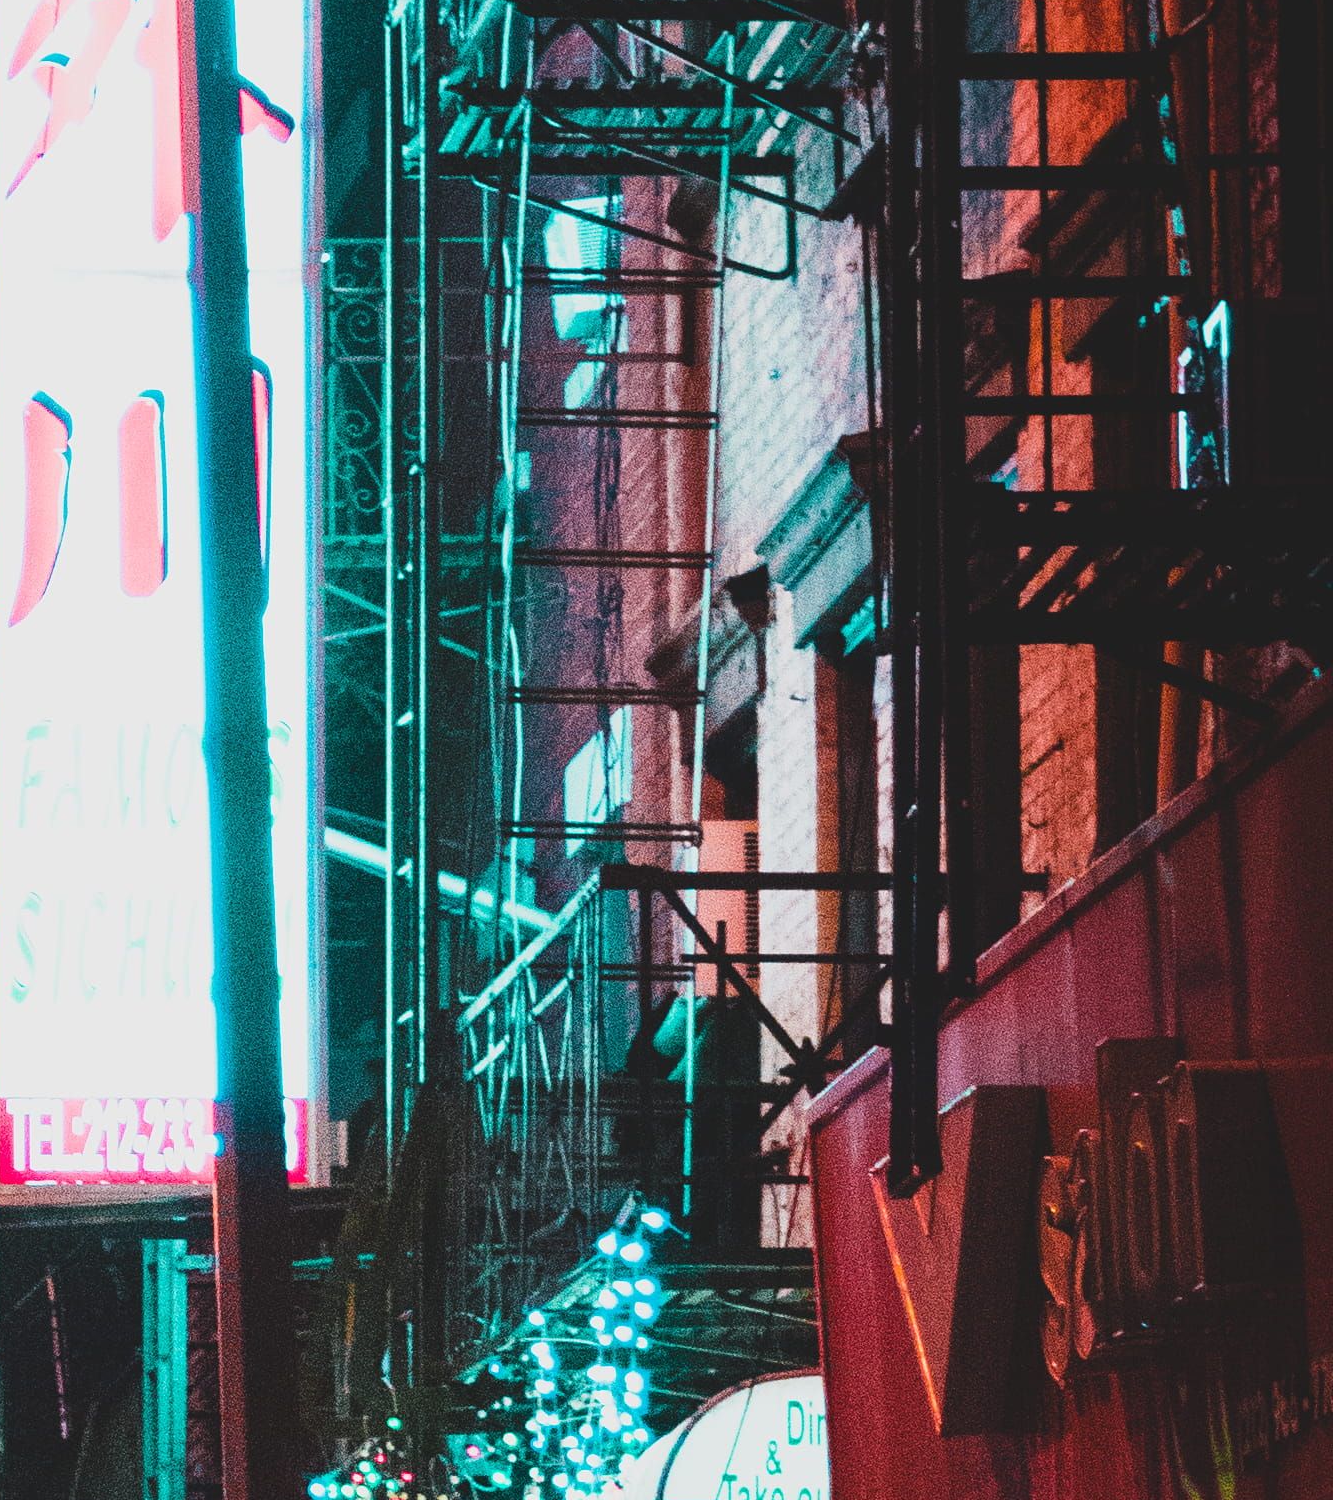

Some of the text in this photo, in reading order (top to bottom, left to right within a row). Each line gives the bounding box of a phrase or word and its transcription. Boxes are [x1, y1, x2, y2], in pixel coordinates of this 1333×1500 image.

[15, 720, 293, 832] FAMOS
[9, 888, 297, 1008] SICHU
[765, 1440, 791, 1476] &
